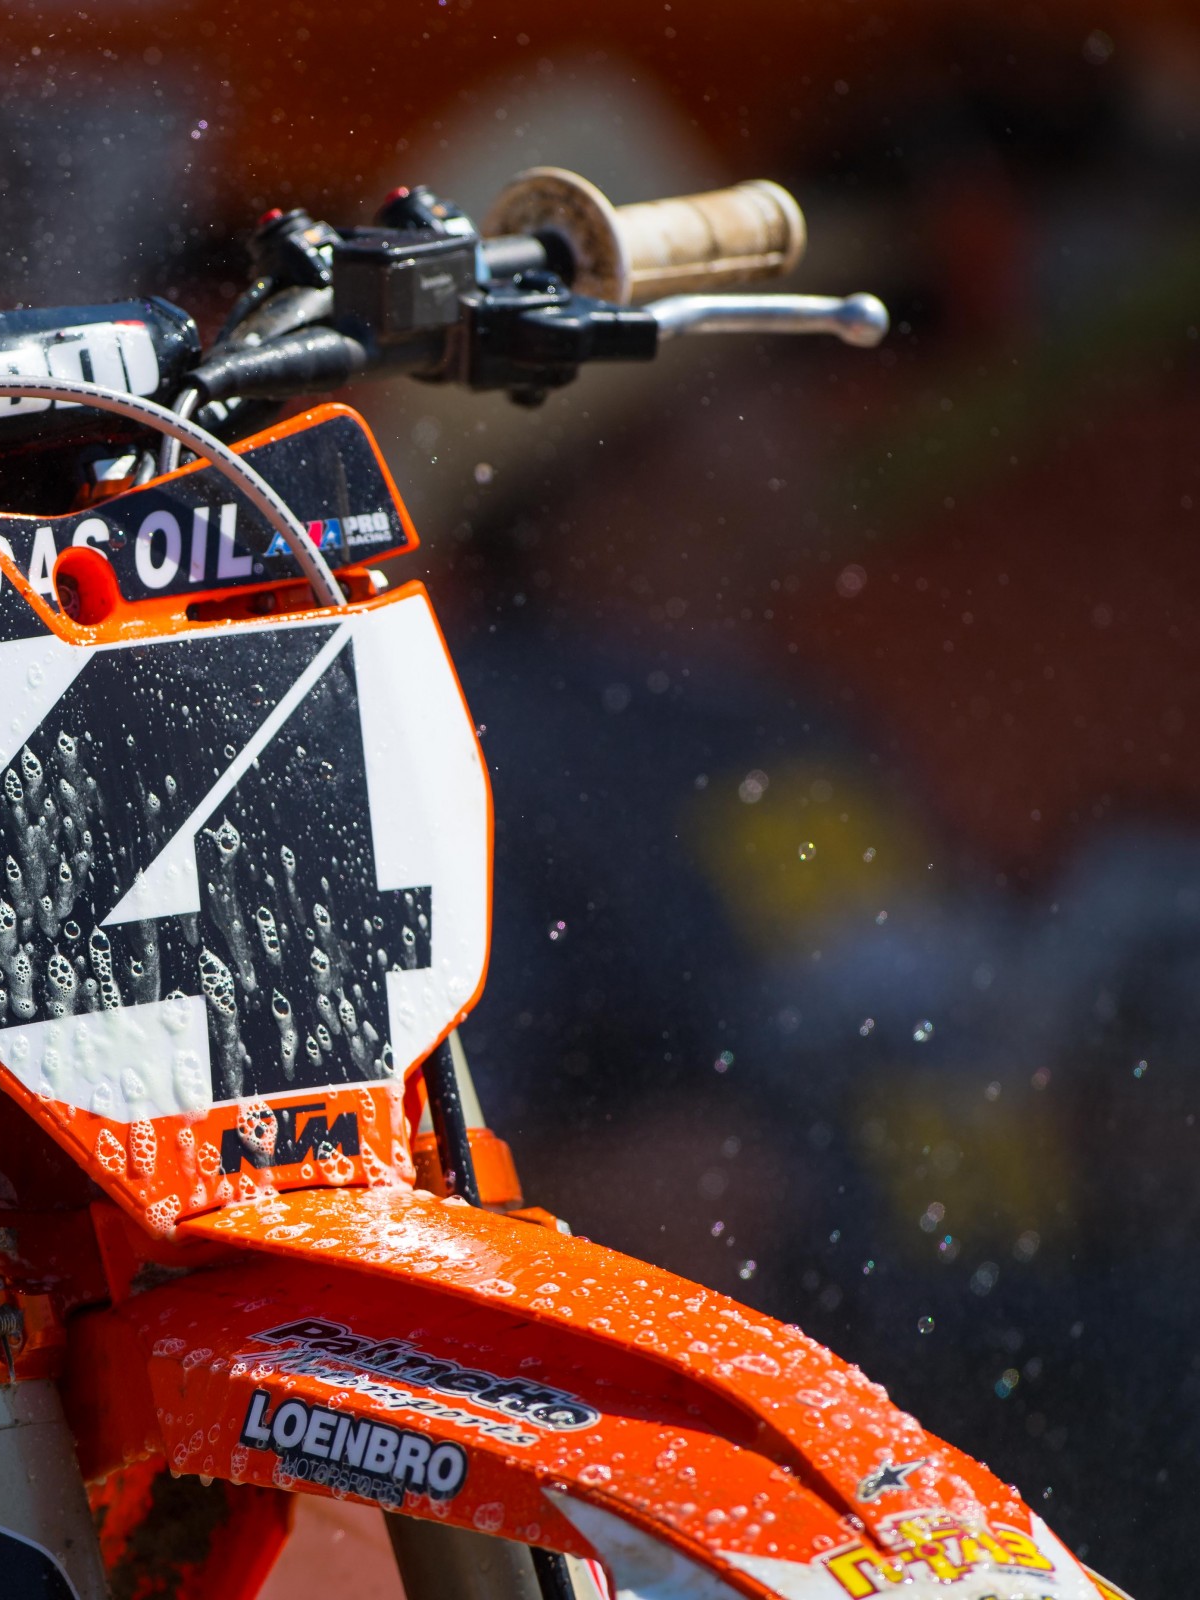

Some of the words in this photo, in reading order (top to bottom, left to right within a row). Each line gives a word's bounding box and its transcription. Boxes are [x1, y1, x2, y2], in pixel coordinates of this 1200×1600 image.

[135, 503, 253, 589] OIL
[342, 512, 390, 536] PRO
[346, 530, 393, 547] RACING
[218, 1102, 361, 1175] KTM
[248, 1317, 602, 1432] Palmetto
[244, 1393, 468, 1493] LOENBRO
